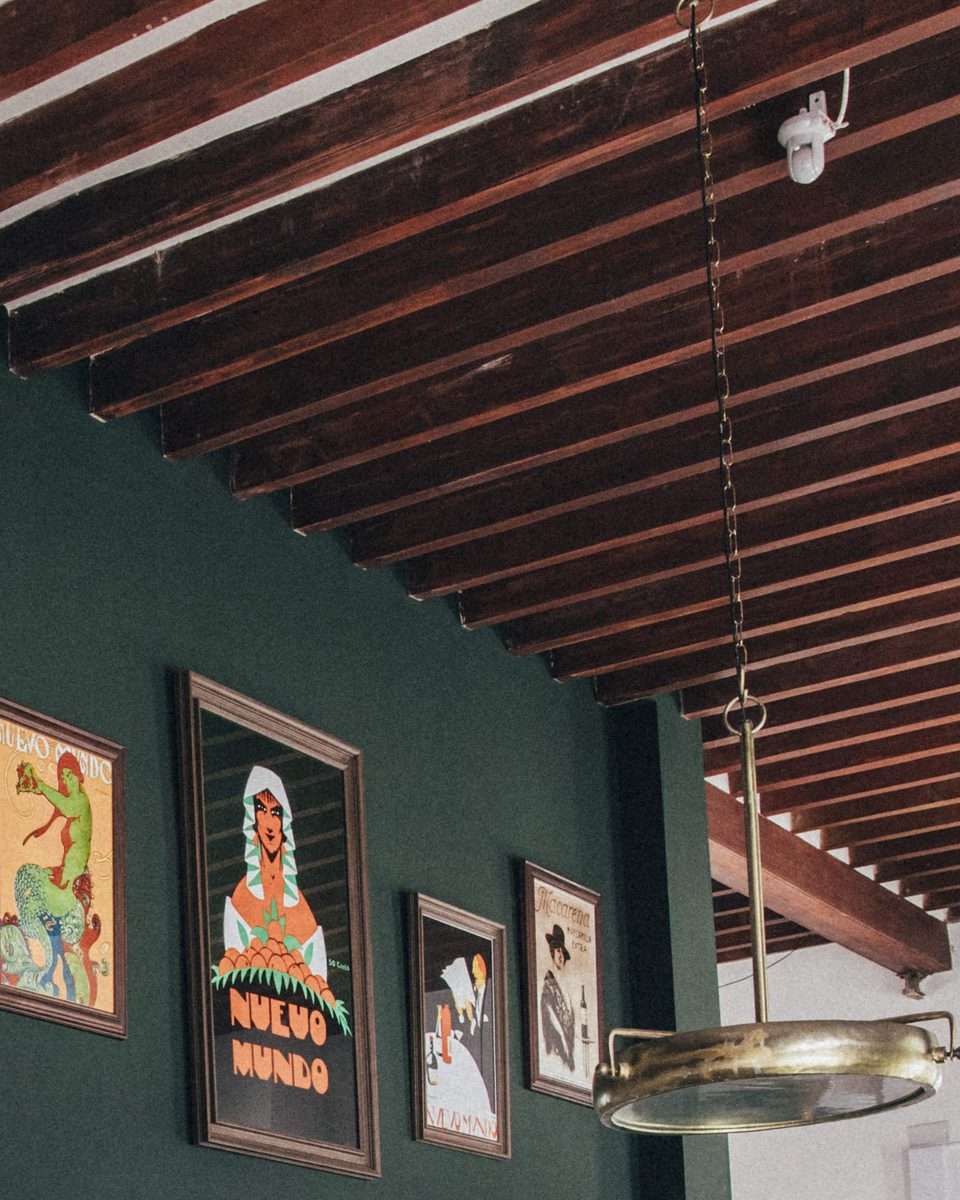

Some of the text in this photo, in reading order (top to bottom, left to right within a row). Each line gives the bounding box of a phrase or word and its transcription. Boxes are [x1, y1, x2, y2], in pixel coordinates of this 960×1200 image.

[535, 886, 591, 928] Macarena
[229, 987, 327, 1046] NUEVO
[231, 1039, 329, 1095] MUNDO
